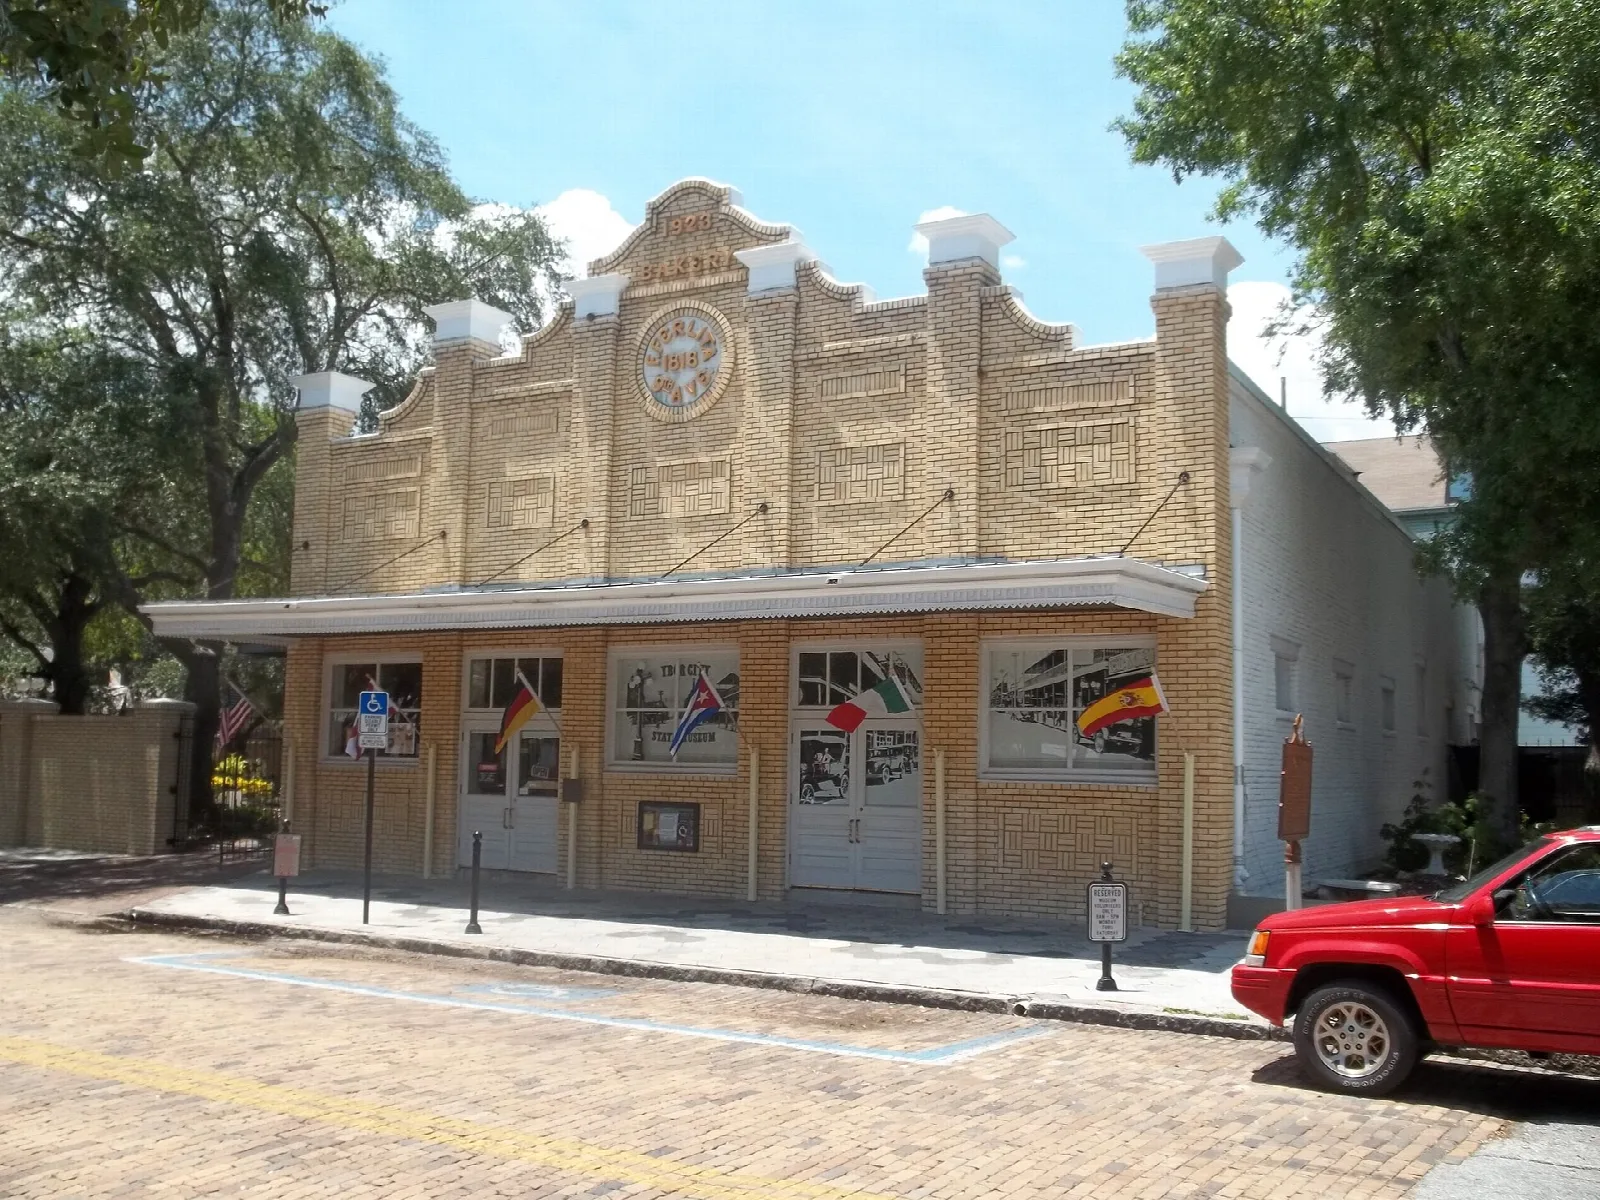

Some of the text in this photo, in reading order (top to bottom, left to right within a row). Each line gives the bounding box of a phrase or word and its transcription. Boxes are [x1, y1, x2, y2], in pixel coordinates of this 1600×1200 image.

[660, 212, 711, 237] 1923
[642, 250, 734, 280] BAKERY
[662, 351, 699, 372] 1818
[671, 370, 712, 403] AVE
[1094, 889, 1121, 897] RESERVED
